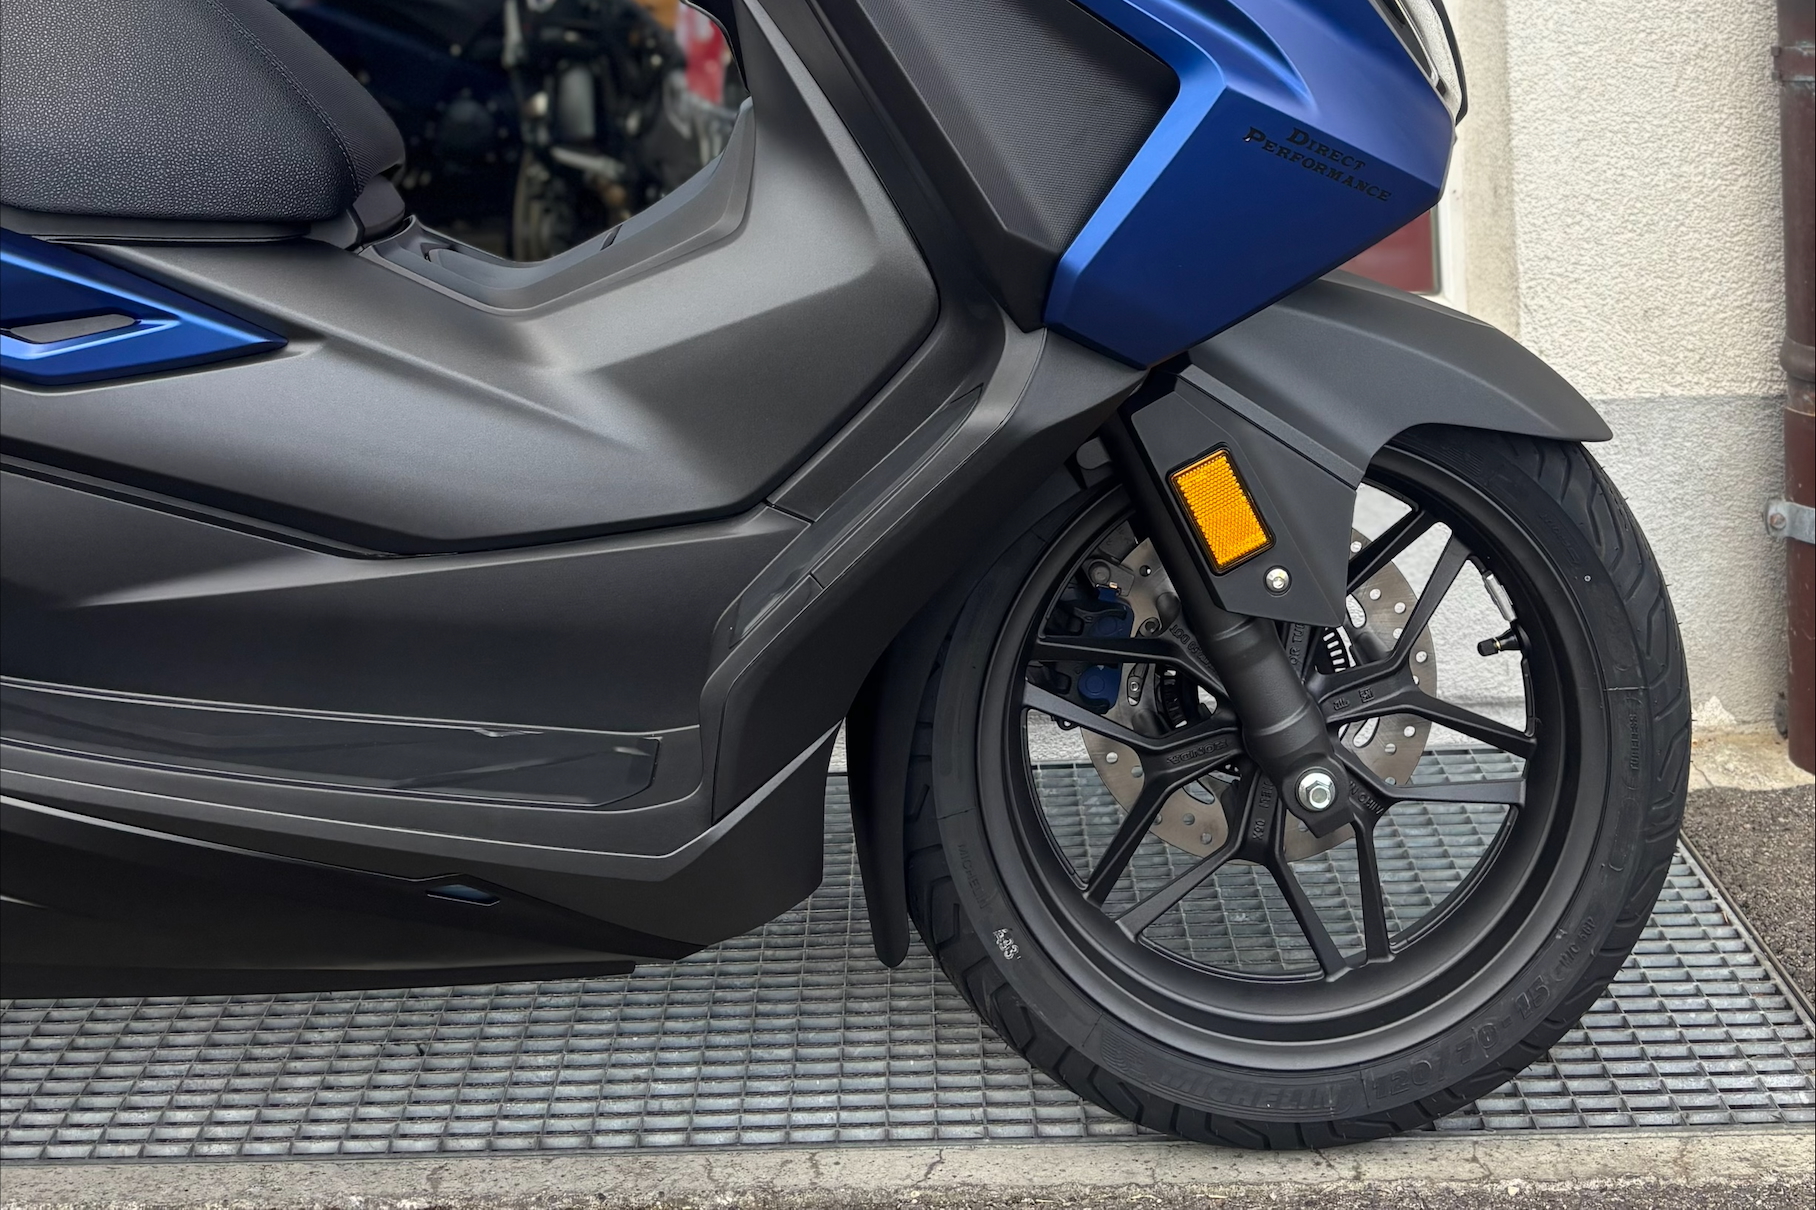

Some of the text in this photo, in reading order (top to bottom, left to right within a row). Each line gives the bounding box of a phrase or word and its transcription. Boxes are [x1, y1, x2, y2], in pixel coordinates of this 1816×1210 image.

[1242, 126, 1392, 202] PERFORMANCE
[1286, 127, 1366, 171] DIRECT
[1169, 624, 1190, 645] DOT
[1166, 738, 1229, 766] HONDA
[957, 843, 990, 910] MICHELIN
[1159, 1067, 1337, 1110] MICHELIN
